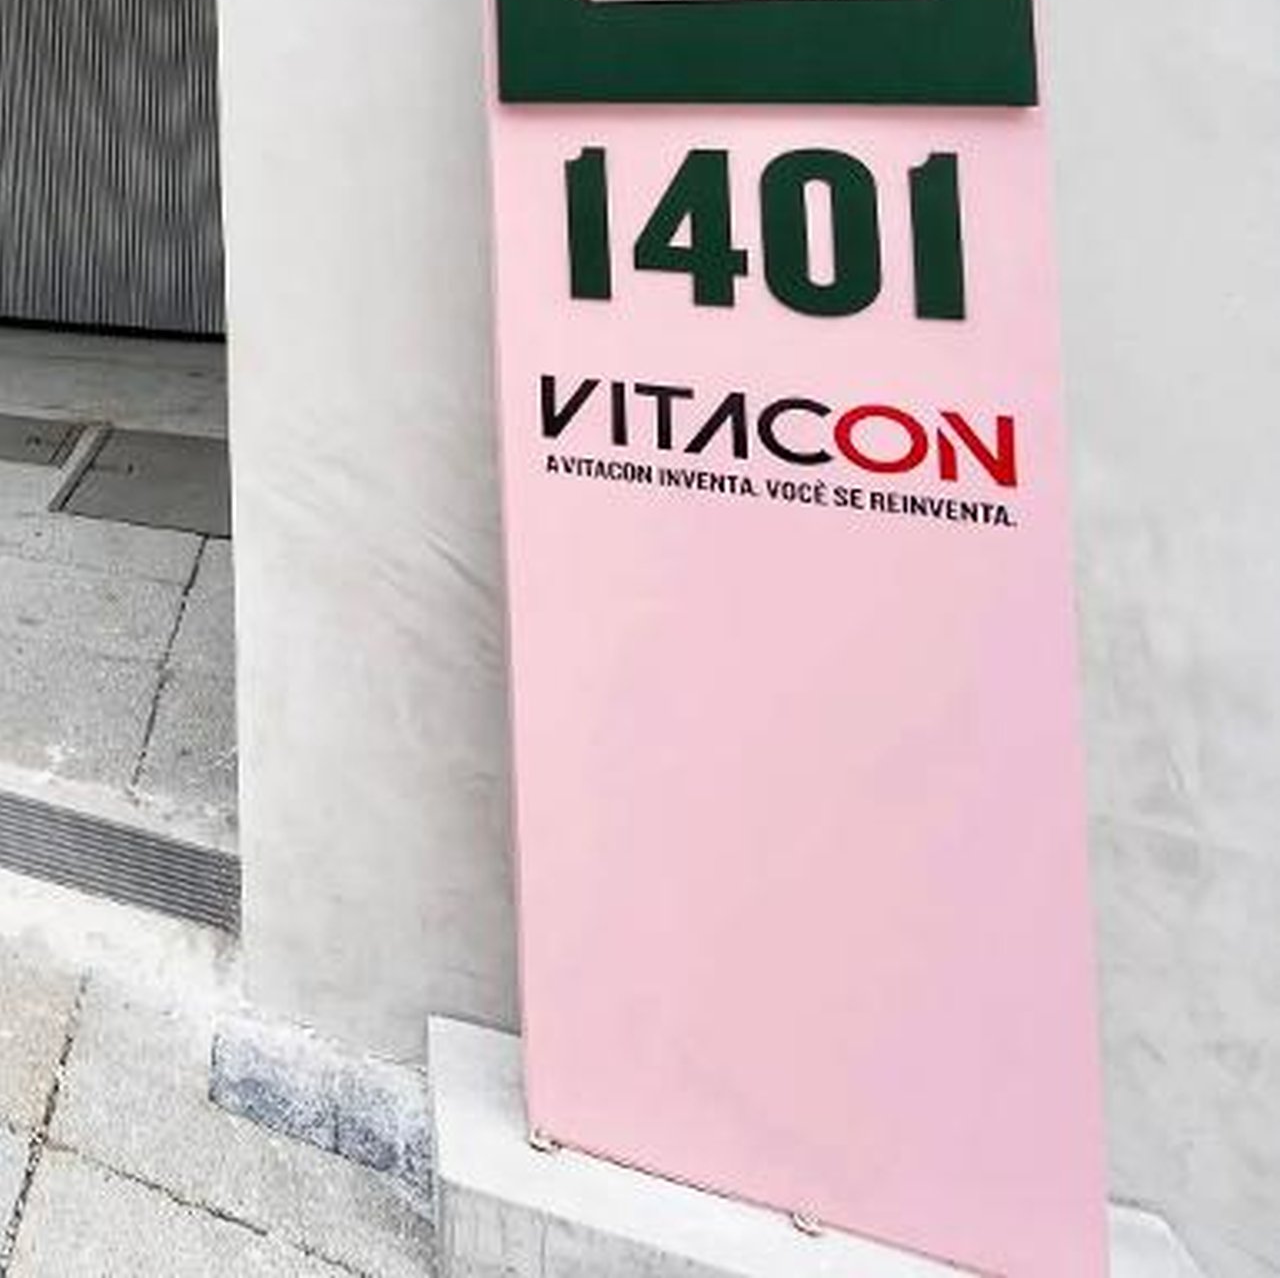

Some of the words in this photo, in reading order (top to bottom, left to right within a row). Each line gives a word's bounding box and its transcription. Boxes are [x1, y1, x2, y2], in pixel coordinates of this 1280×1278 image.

[565, 147, 966, 321] 1401
[540, 374, 1017, 488] VITACON
[546, 455, 559, 473] A
[560, 456, 652, 484] VITACON
[659, 468, 759, 497] INVENTA.
[766, 479, 828, 506] VOCÊ
[833, 485, 864, 509] SE
[870, 491, 1017, 527] REINVENTA.
